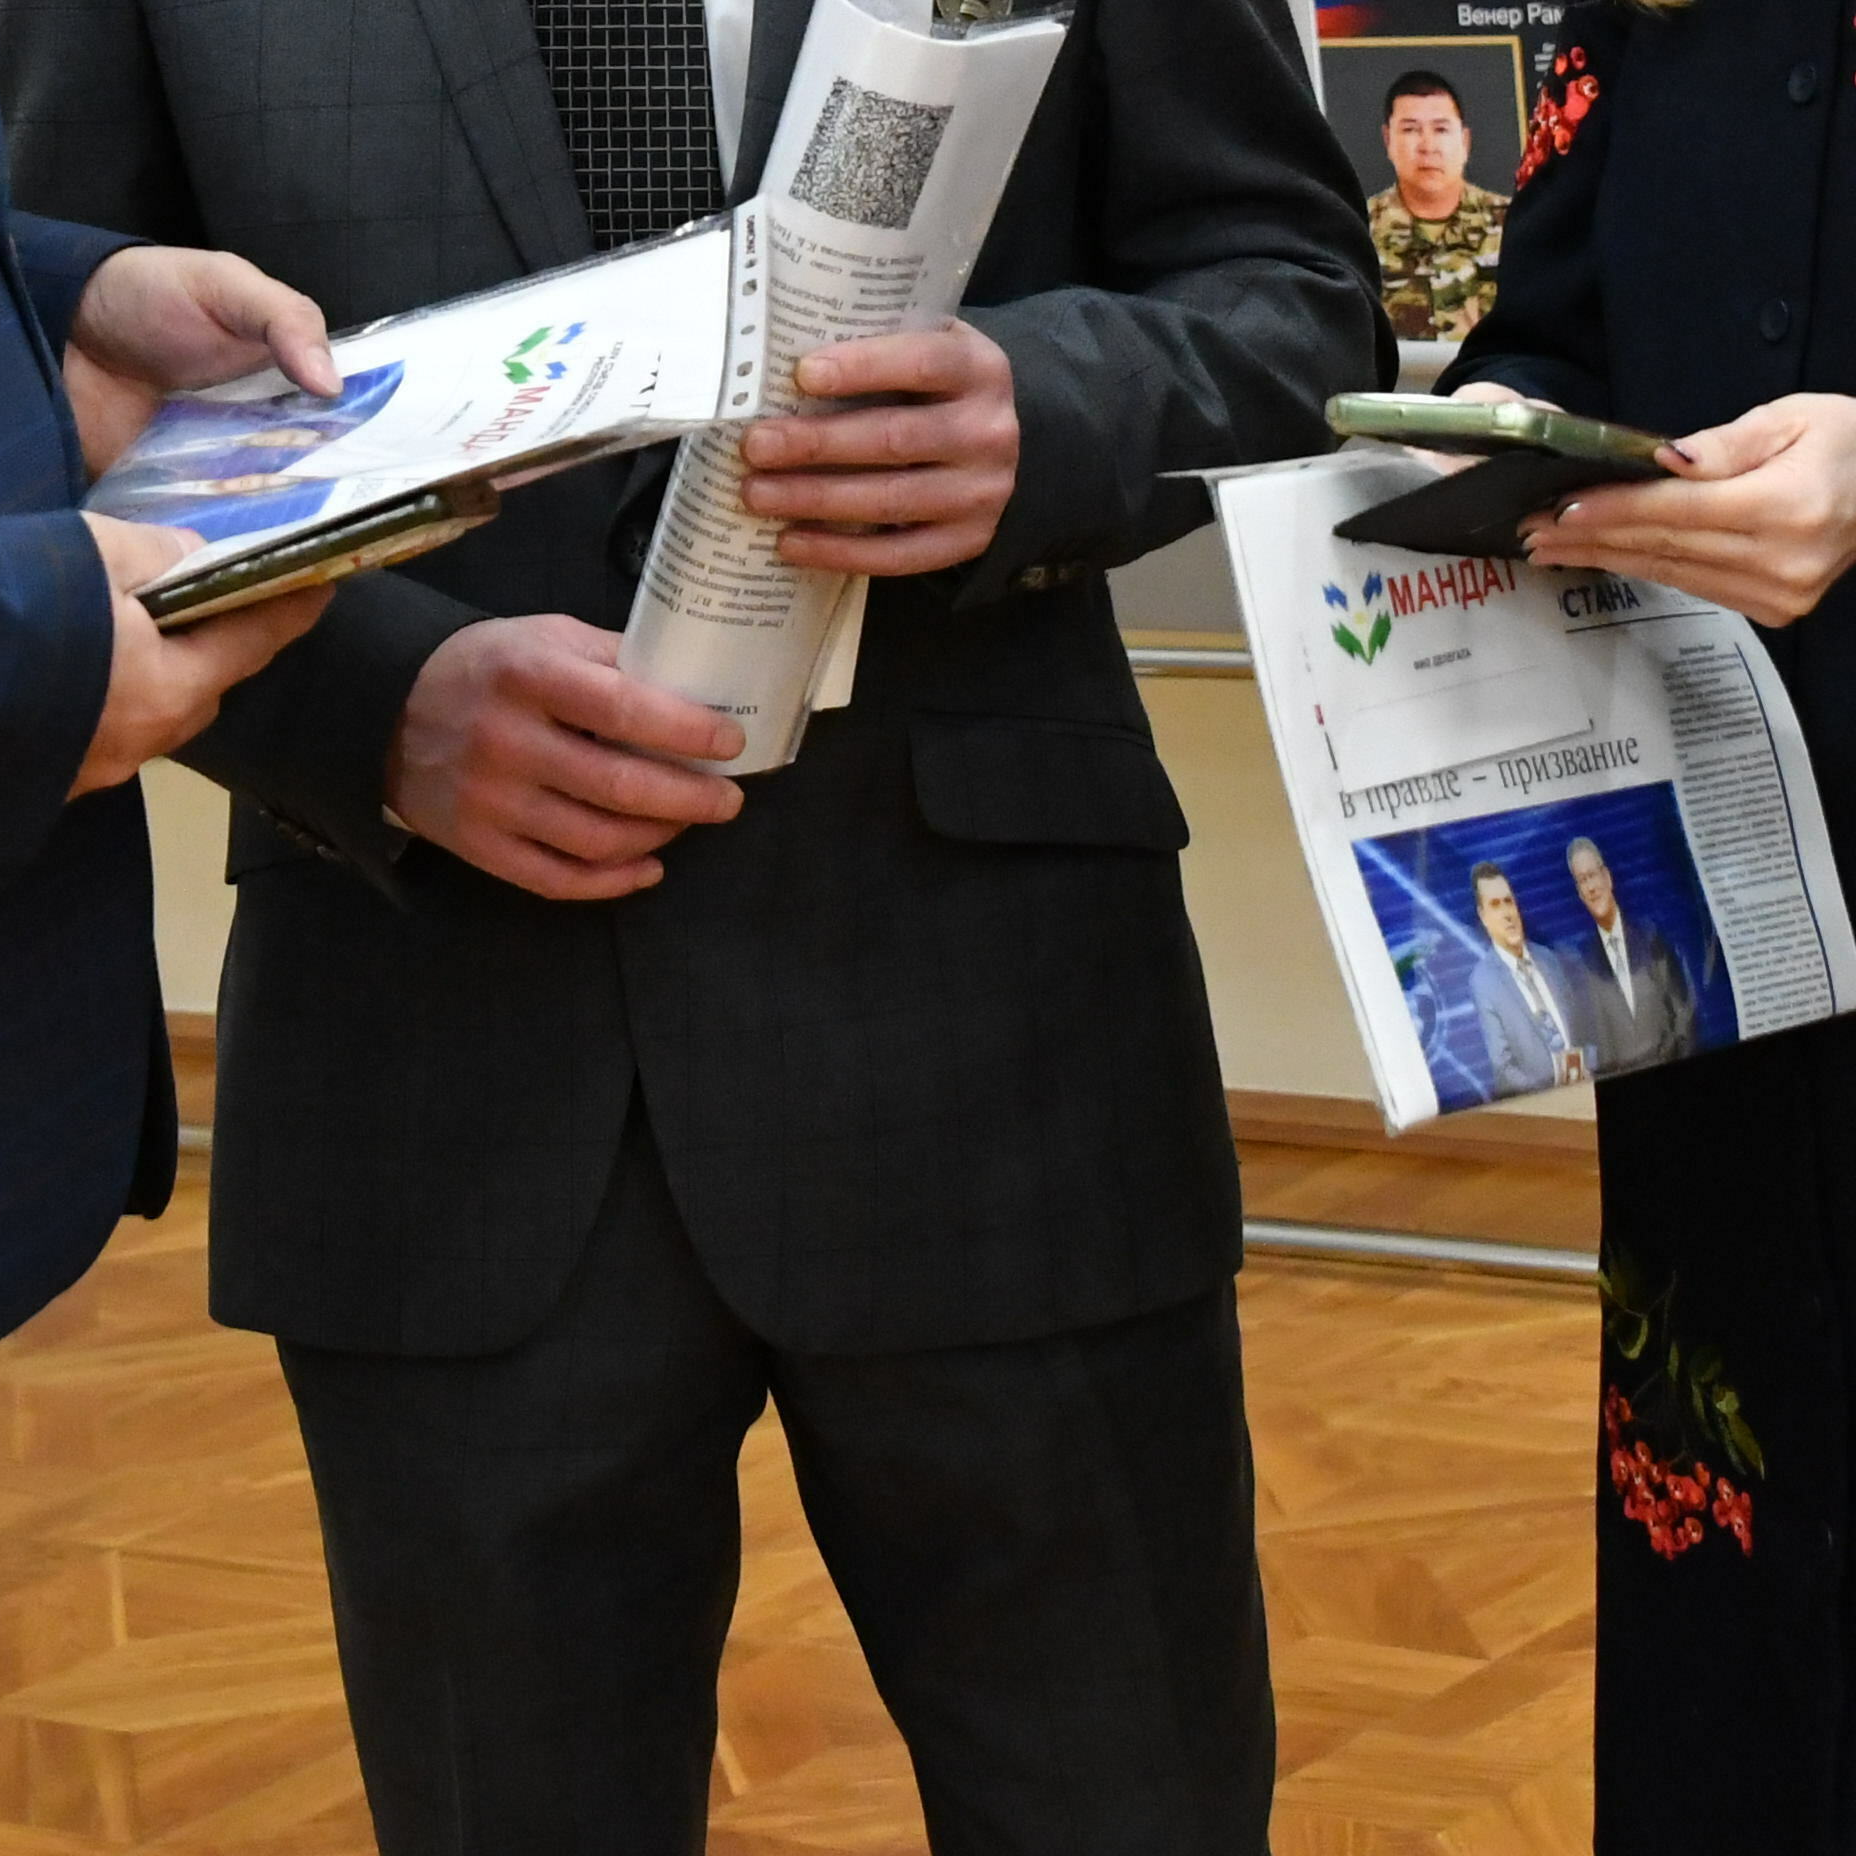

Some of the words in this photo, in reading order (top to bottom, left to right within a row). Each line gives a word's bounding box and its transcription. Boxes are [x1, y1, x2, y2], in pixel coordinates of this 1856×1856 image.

[1457, 2, 1524, 30] Венер
[1526, 2, 1565, 25] Рам
[1386, 557, 1517, 618] МАНДАТ
[1557, 581, 1642, 619] СТАНА
[1364, 768, 1462, 819] правде
[1497, 736, 1640, 794] призвание
